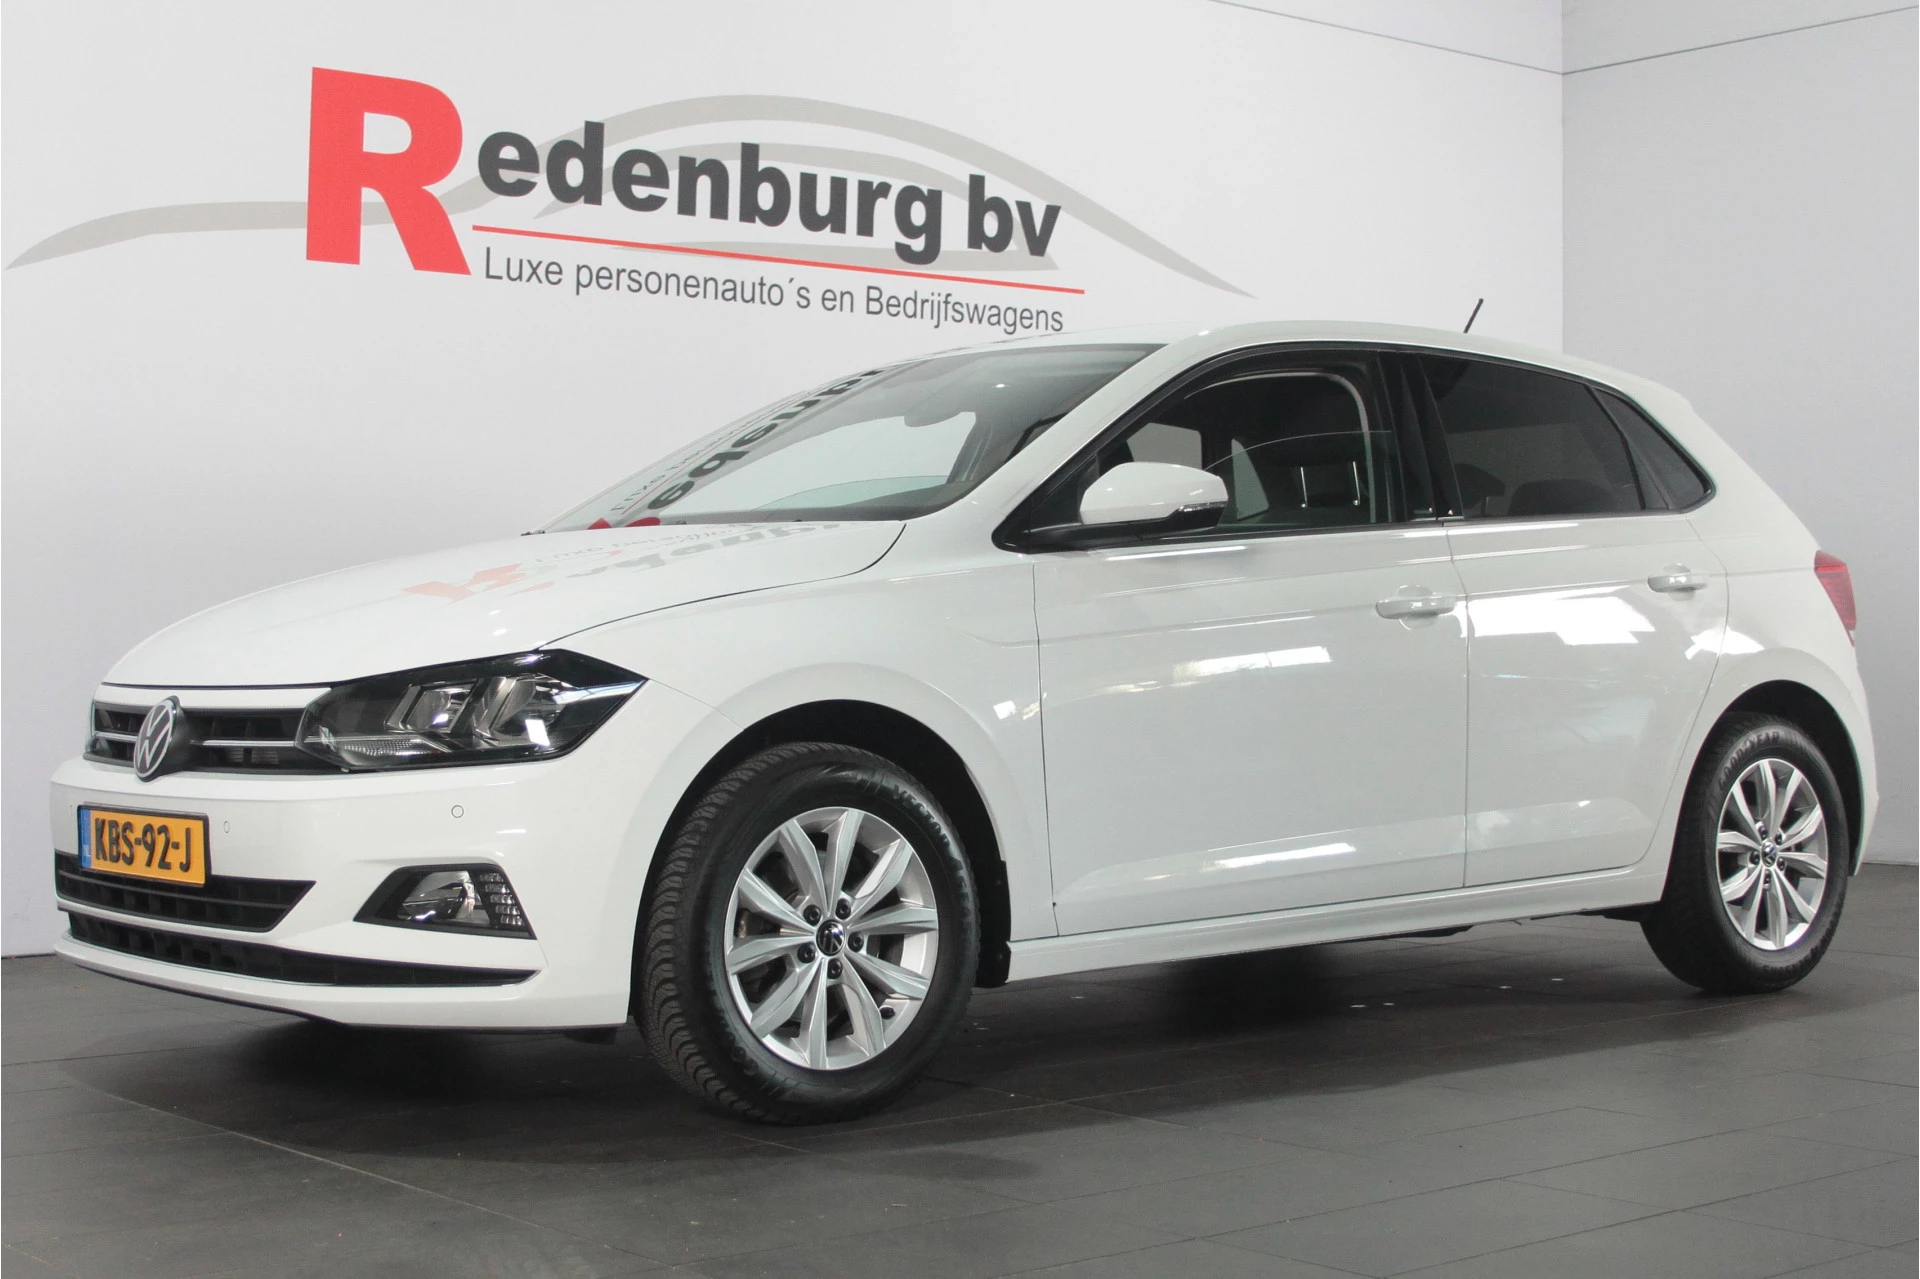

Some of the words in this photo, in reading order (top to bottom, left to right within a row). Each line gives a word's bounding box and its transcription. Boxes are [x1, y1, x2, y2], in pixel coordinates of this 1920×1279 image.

[306, 67, 943, 275] Redenburg
[967, 173, 1062, 258] bv
[485, 246, 563, 286] Luxe
[821, 289, 854, 313] en
[866, 285, 1063, 335] Bedrijfswagens
[94, 817, 192, 873] KBS-92-J
